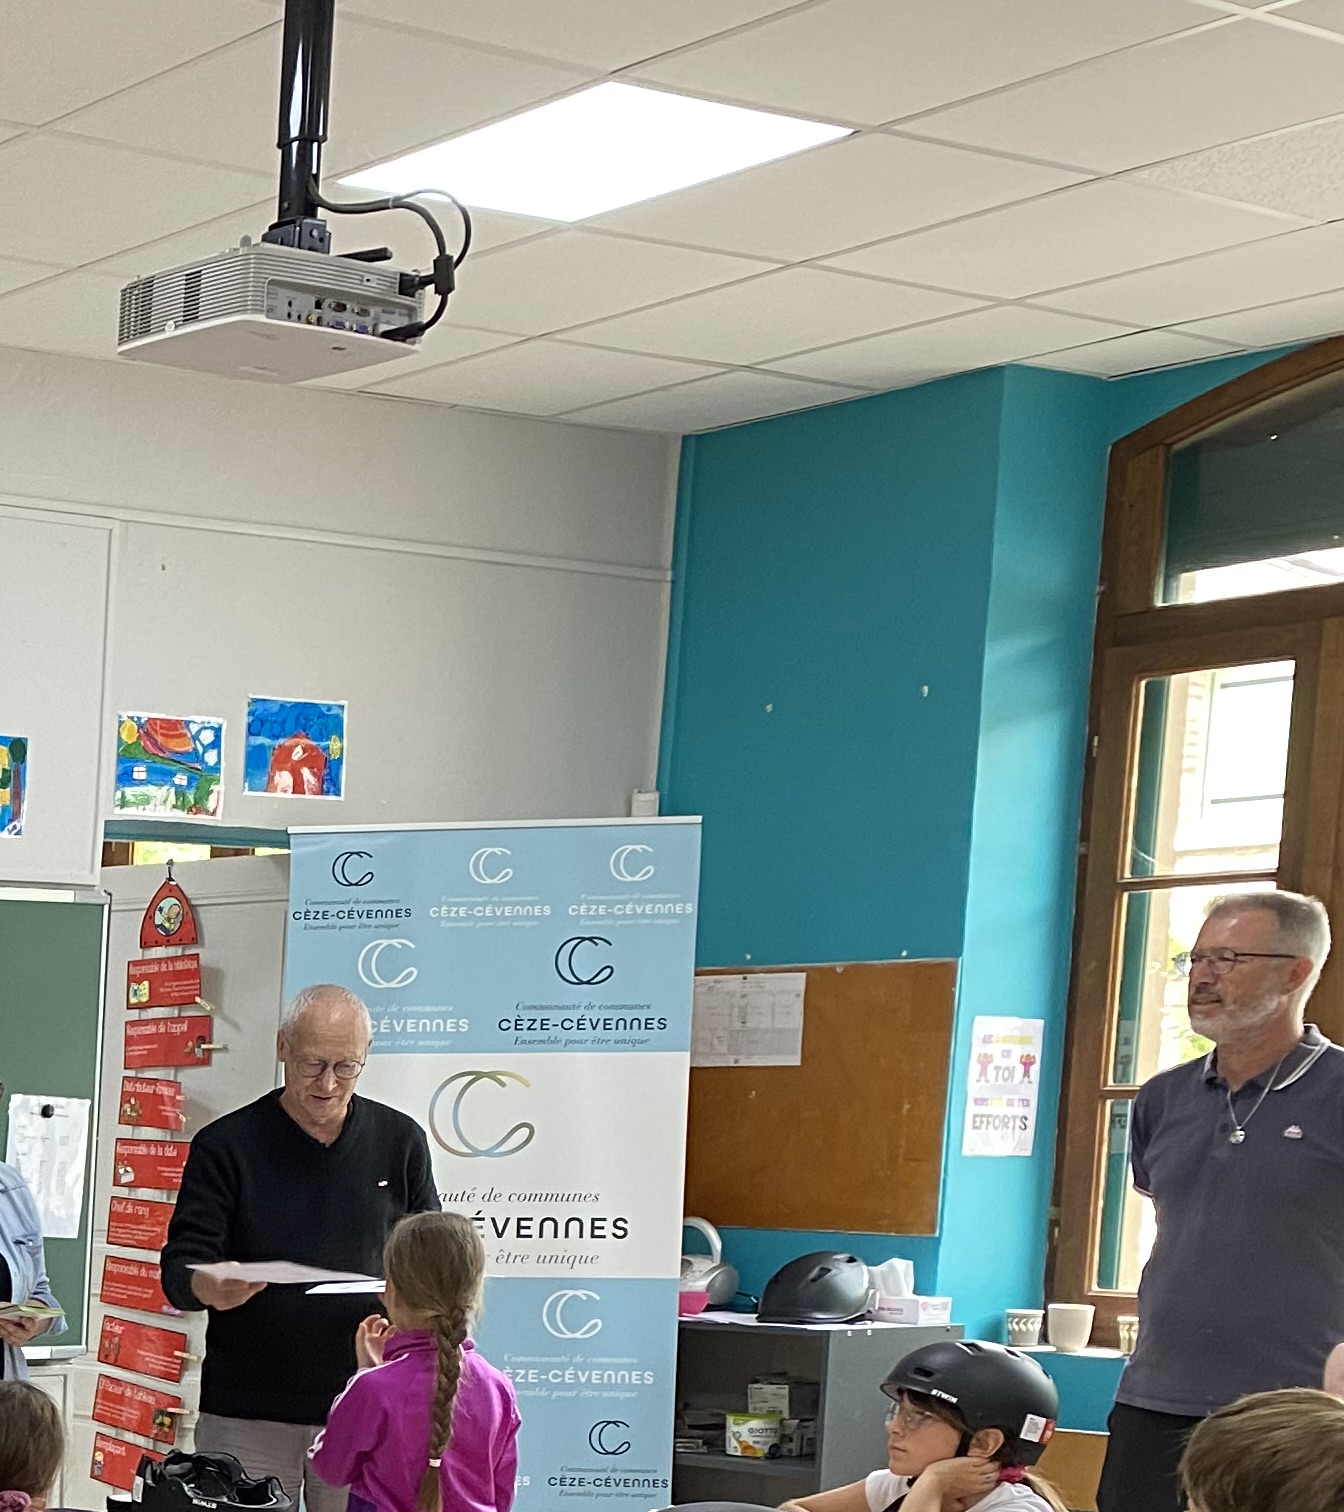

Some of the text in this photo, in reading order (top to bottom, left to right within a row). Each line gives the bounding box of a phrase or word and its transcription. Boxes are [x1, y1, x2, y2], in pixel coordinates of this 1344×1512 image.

[292, 905, 412, 922] CÈZE-CÉVENNES
[429, 903, 551, 918] CÈZE-CÉVENNES
[568, 901, 693, 917] CÈZE-CÉVENNES
[515, 1000, 652, 1012] Communauté de communes
[369, 1015, 470, 1033] CÉVENNES
[497, 1014, 668, 1032] CÈZE-CÉVENNES
[513, 1035, 650, 1049] Ensemble pour être unique
[993, 1065, 1016, 1083] TOI
[972, 1114, 1029, 1132] EFFORTS
[481, 1187, 502, 1203] de
[508, 1190, 601, 1203] communes
[469, 1210, 629, 1240] ÉVENNES
[495, 1248, 600, 1270] être unique
[502, 1366, 654, 1385] ÈZE-CÉVENNES
[547, 1475, 669, 1489] CÈZE-CÉVENNES
